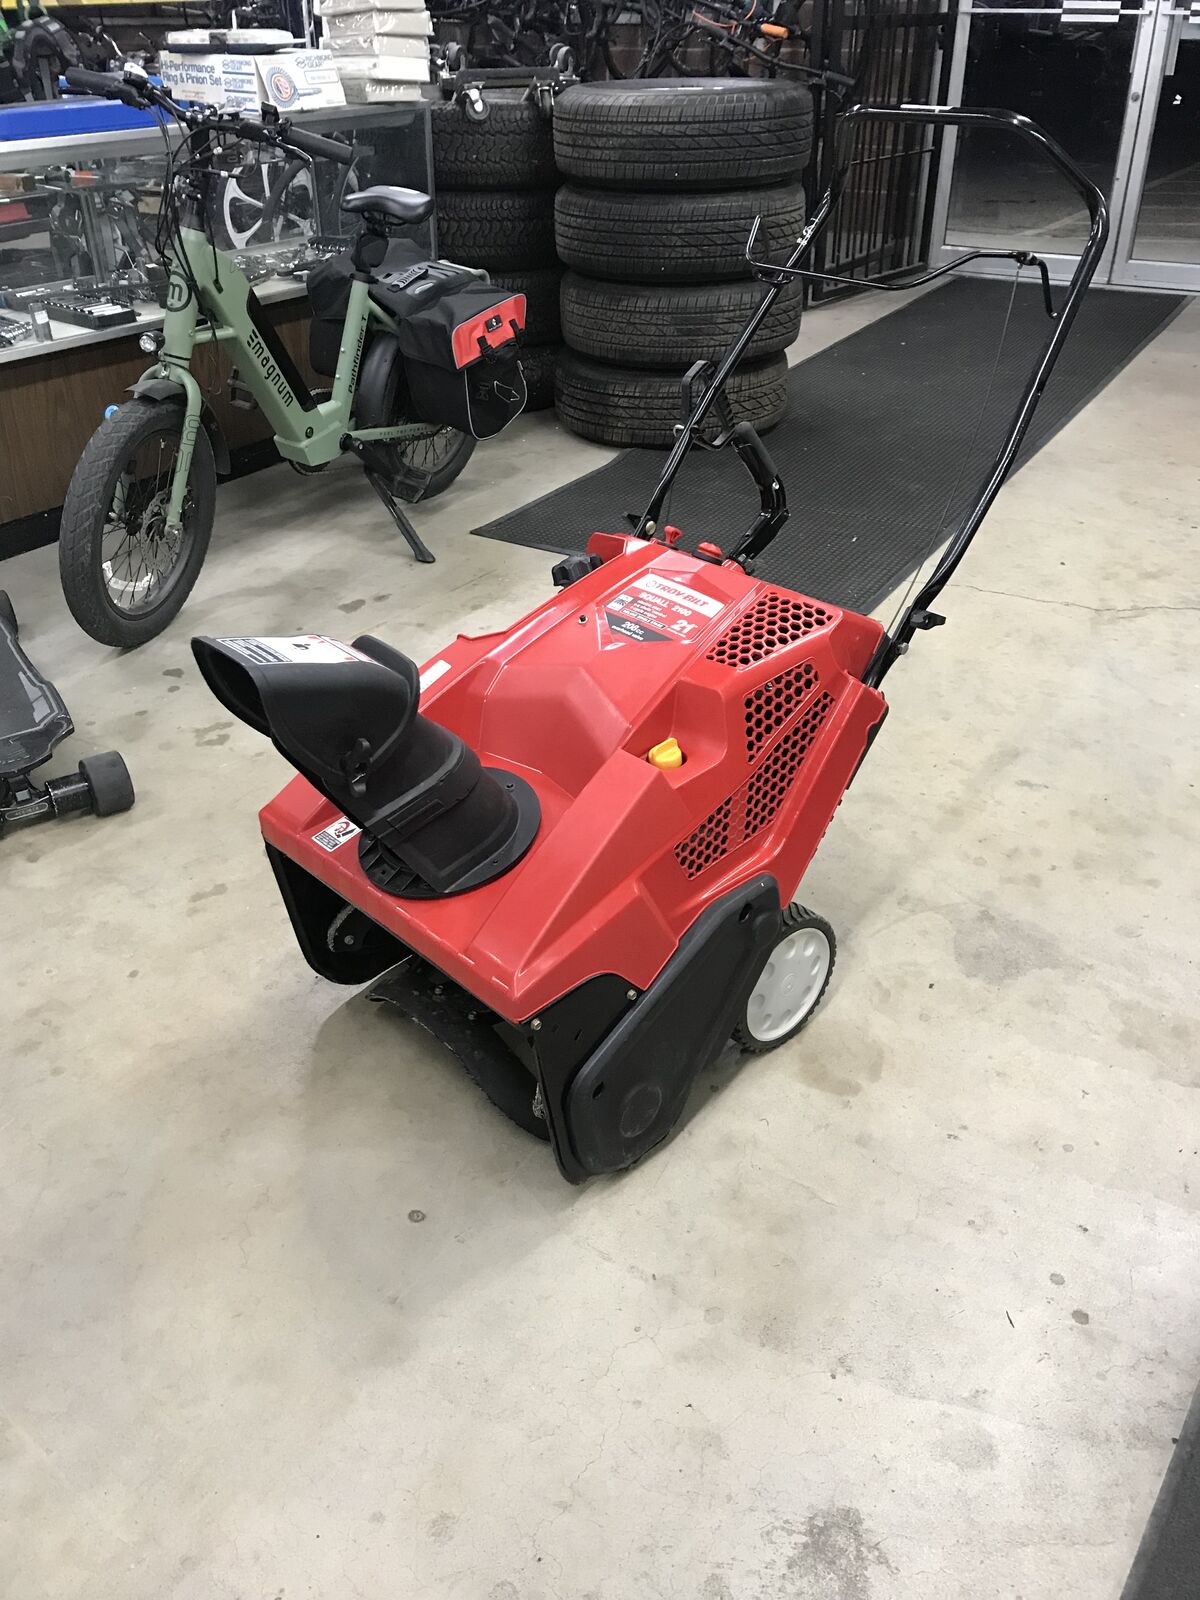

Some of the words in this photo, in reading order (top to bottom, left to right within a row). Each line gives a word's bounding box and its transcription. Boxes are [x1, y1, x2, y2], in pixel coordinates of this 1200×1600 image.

[161, 60, 215, 74] Hi-Performance
[162, 71, 178, 85] Ring
[180, 74, 185, 83] &
[186, 73, 208, 85] Pinion
[209, 74, 222, 86] Set
[348, 327, 366, 394] Pathfinder
[252, 340, 294, 408] magnum
[638, 592, 670, 608] SQUALL
[671, 605, 692, 617] 2100
[655, 583, 710, 608] TROY-BILT
[621, 621, 644, 634] 208cc
